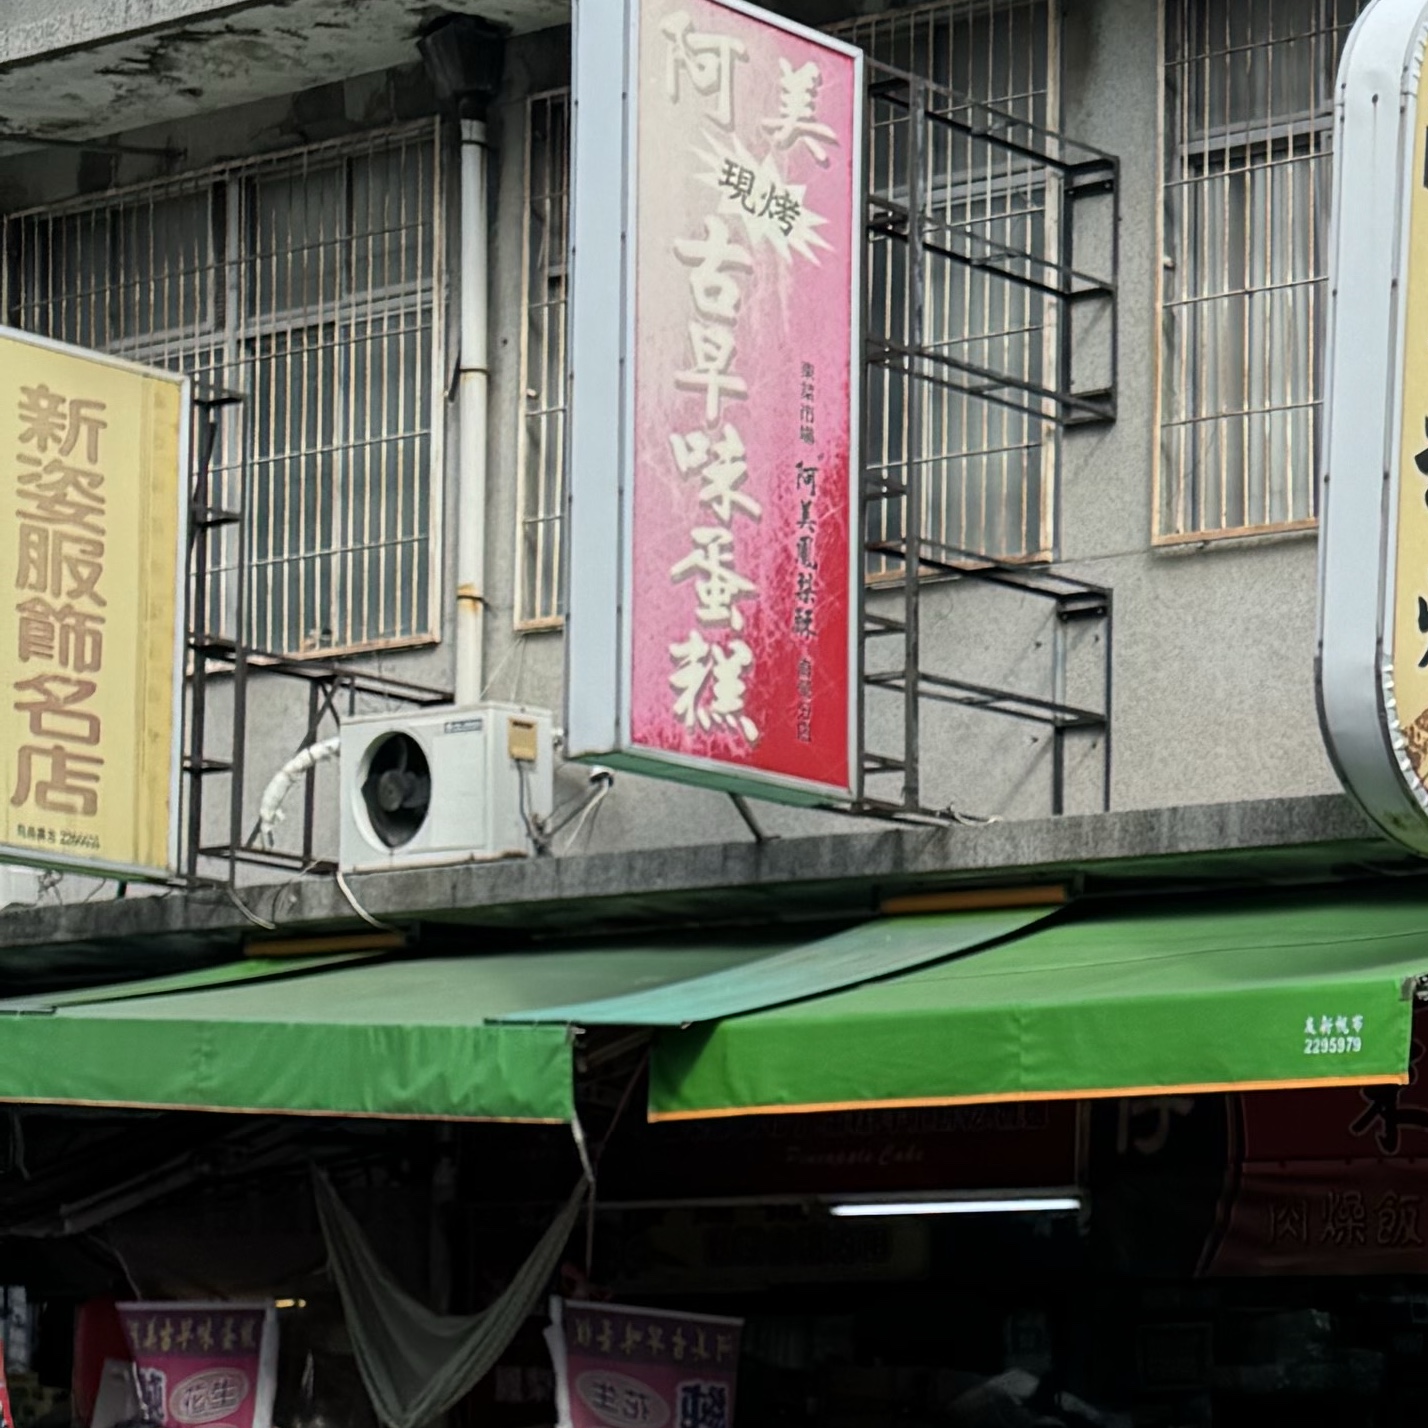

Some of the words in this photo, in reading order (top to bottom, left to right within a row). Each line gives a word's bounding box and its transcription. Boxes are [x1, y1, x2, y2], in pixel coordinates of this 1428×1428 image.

[661, 11, 839, 168] 阿美
[717, 157, 802, 239] 現烤
[668, 216, 762, 748] 古早味蛋糕
[12, 382, 109, 820] 新姿服飾名店
[1269, 1189, 1424, 1247] 肉燥飯
